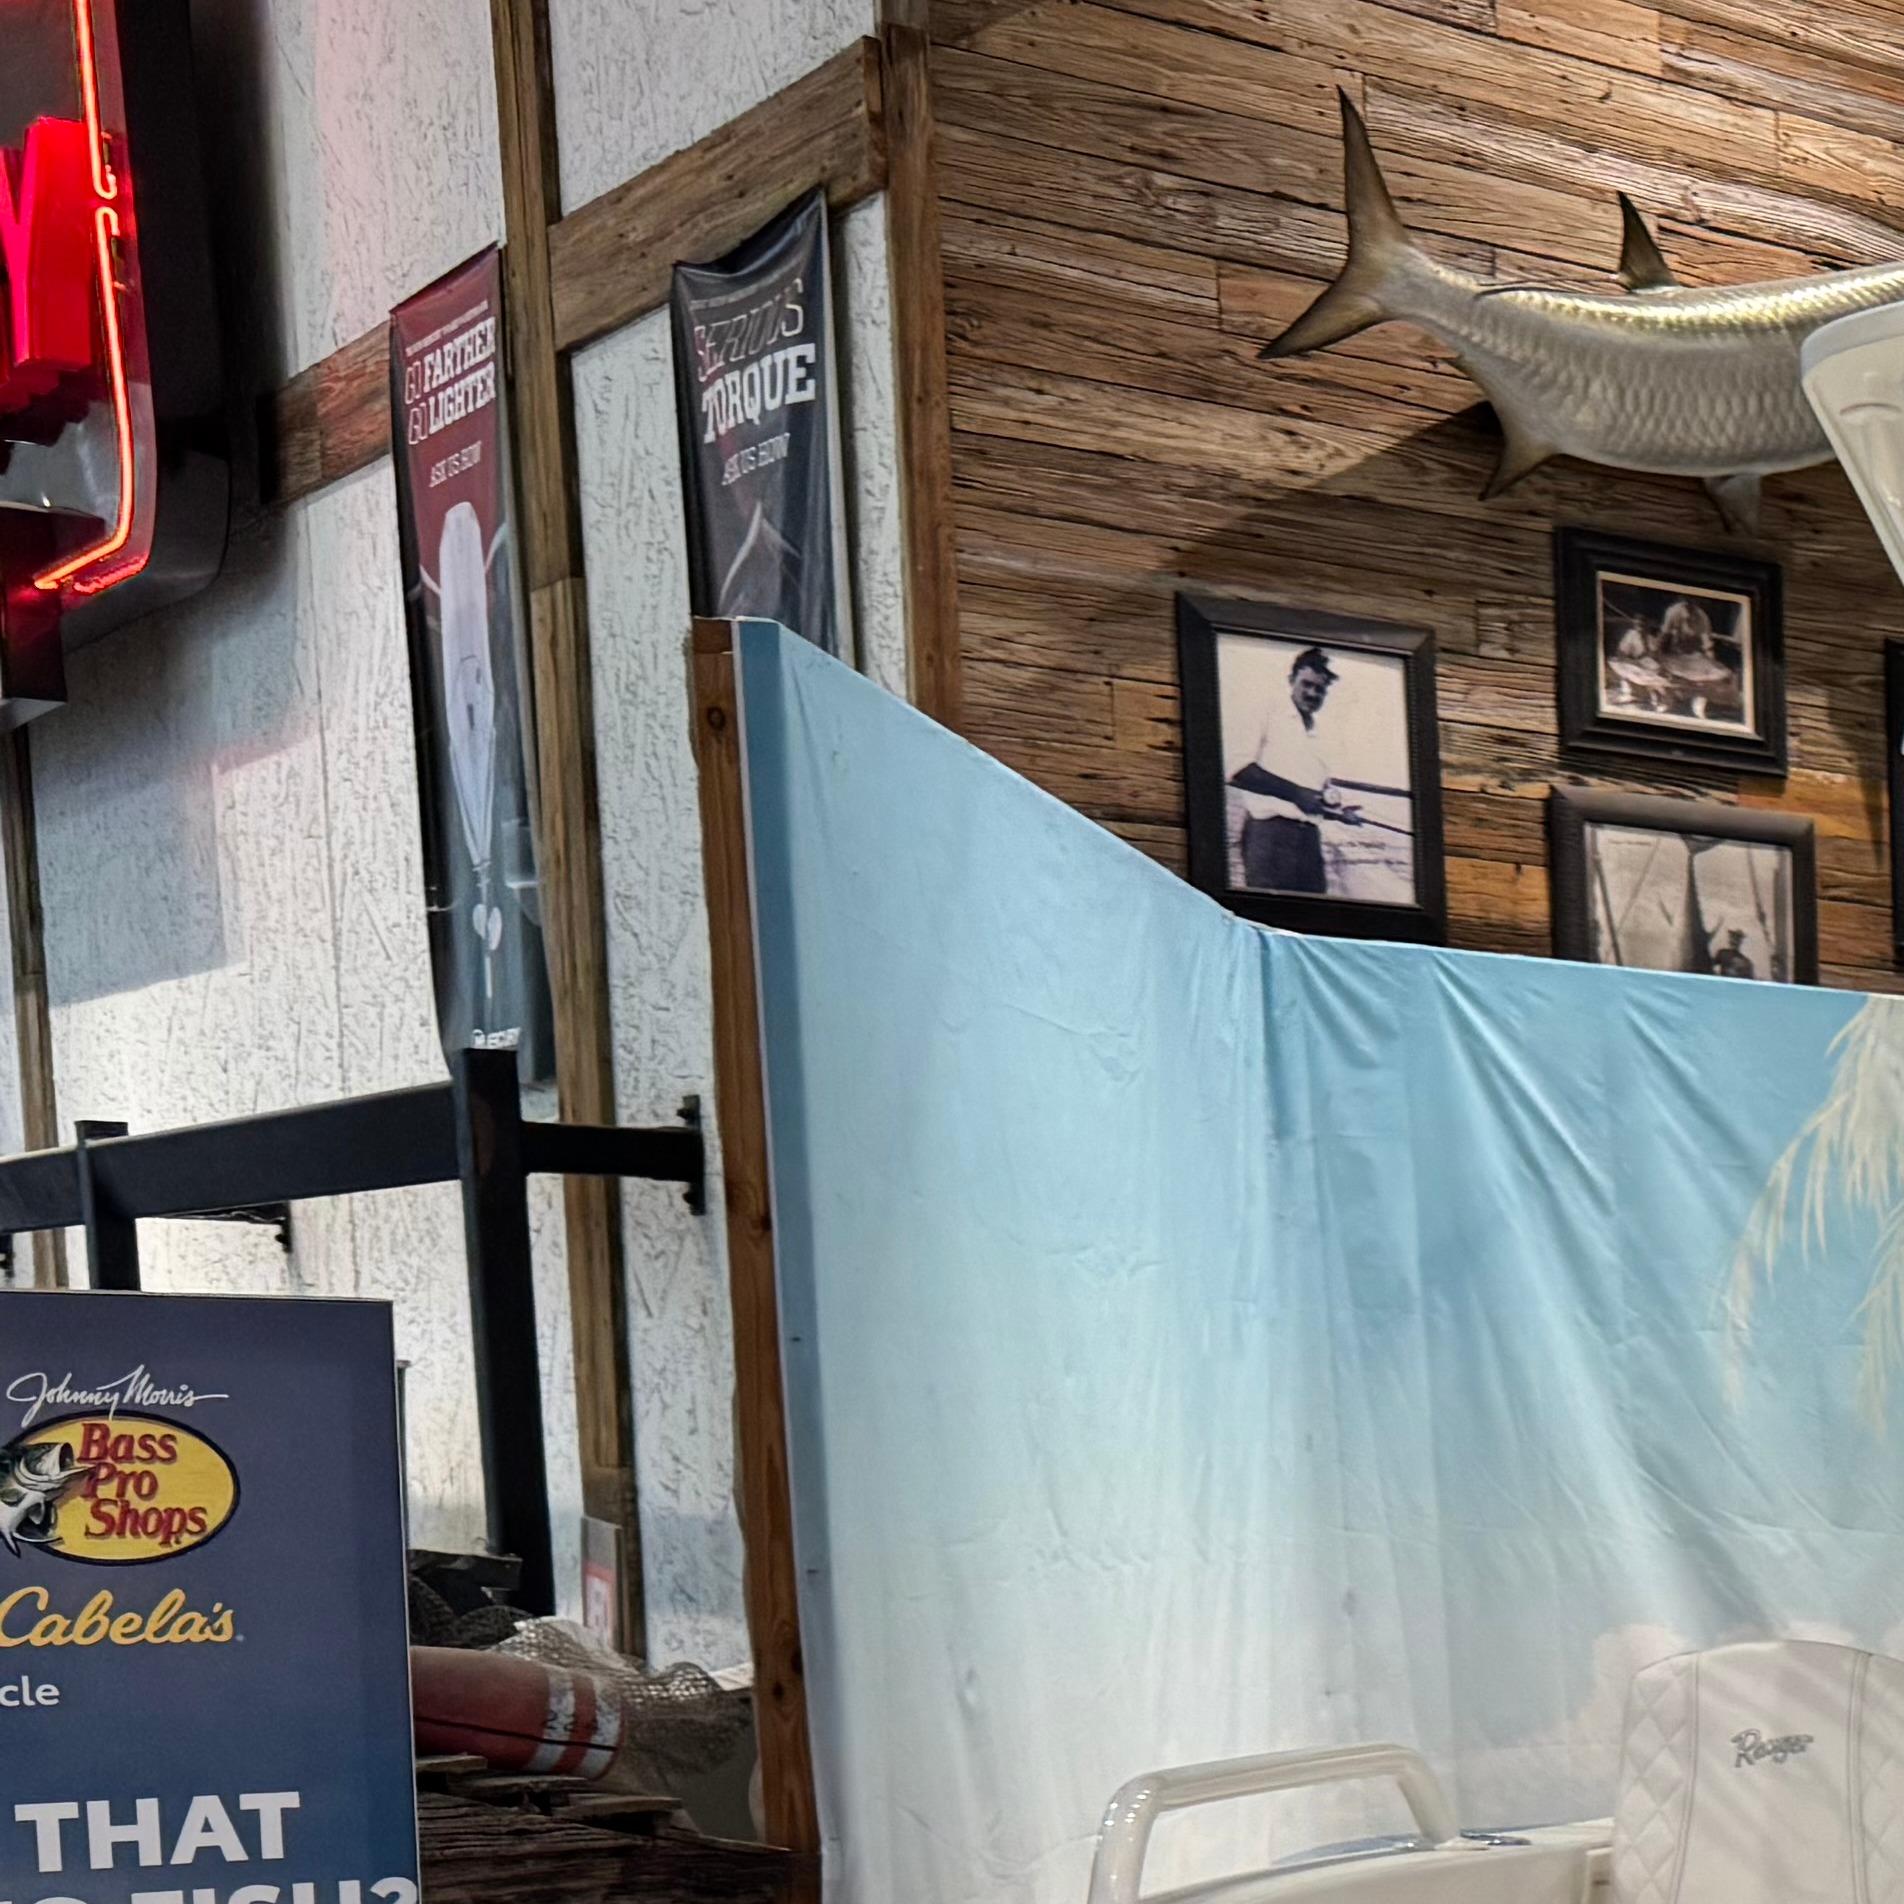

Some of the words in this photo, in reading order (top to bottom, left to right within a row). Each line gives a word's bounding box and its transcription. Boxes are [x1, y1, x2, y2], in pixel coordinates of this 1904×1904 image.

[702, 343, 816, 444] TORQUE
[6, 1372, 120, 1428] Johnny
[97, 1364, 229, 1408] Morris
[76, 1421, 179, 1465] Bass
[80, 1461, 160, 1501] Pro
[85, 1498, 209, 1549] Shops
[0, 1585, 235, 1648] Cabela's
[14, 1791, 301, 1873] THAT
